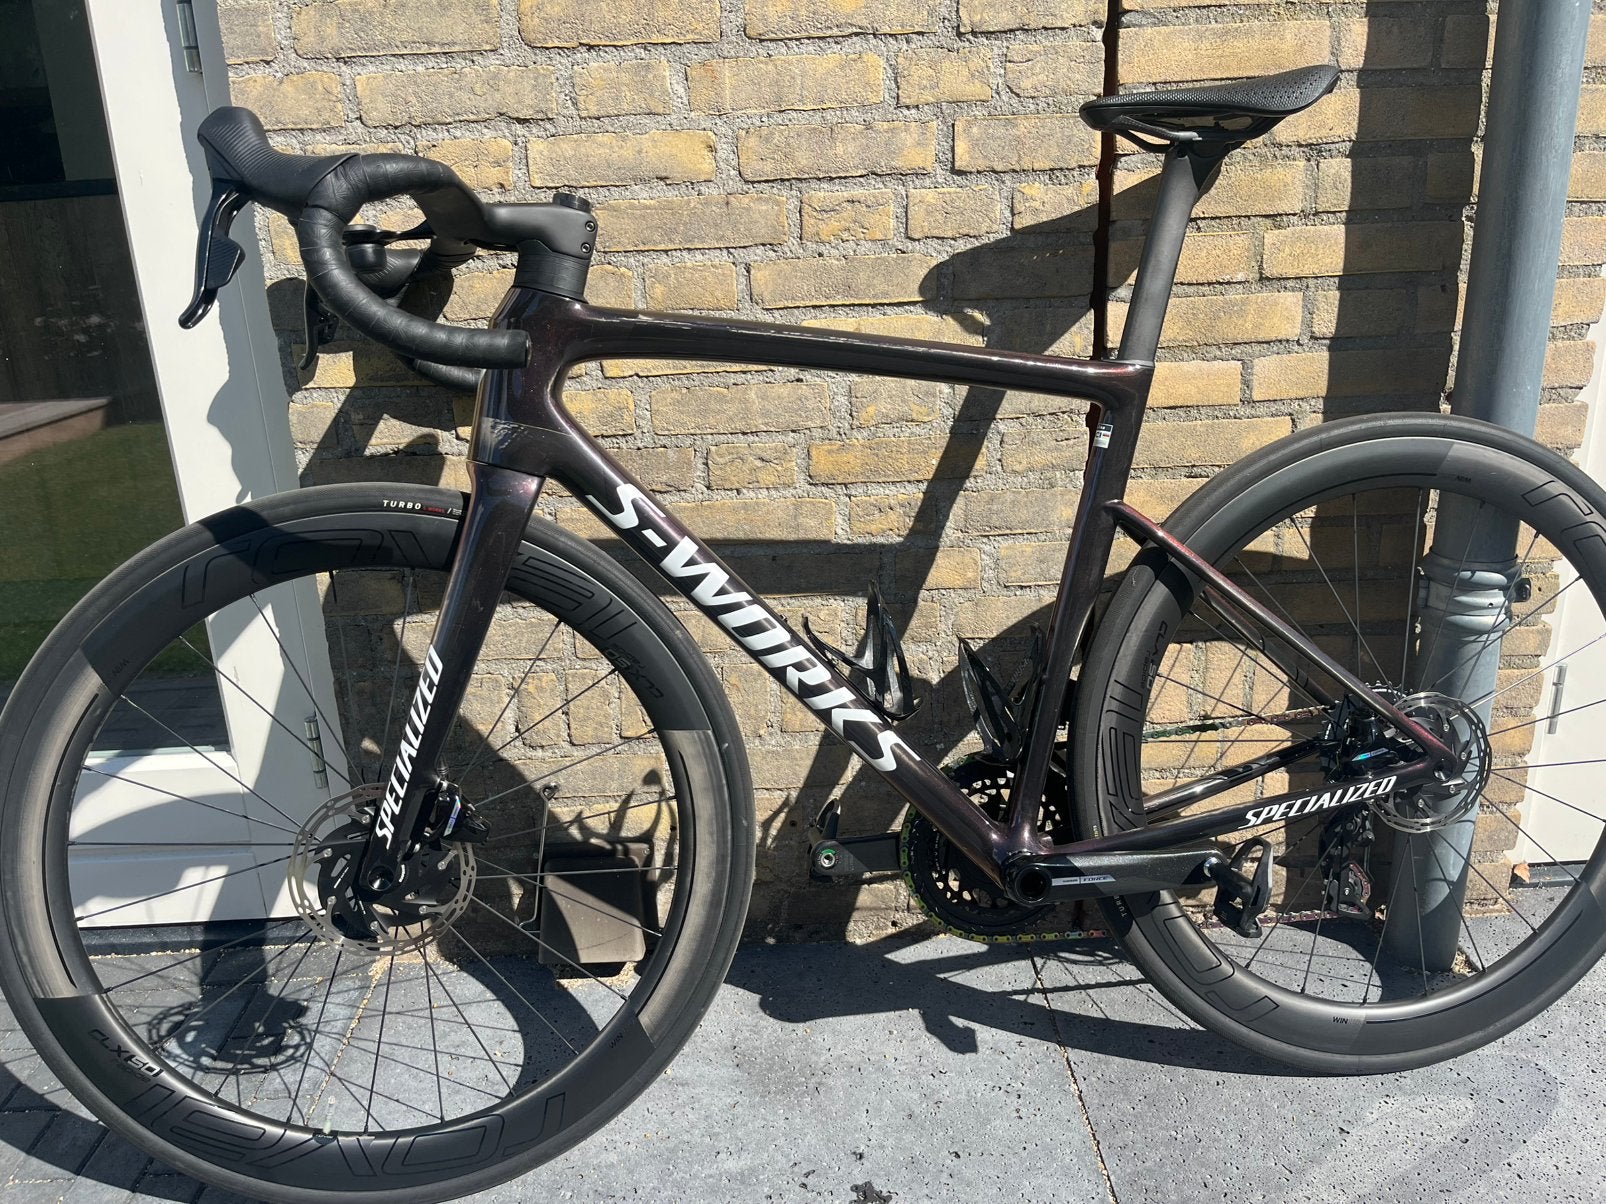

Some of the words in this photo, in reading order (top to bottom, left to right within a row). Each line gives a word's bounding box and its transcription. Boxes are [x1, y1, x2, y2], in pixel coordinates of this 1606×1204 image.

[382, 499, 422, 510] TURBO
[585, 483, 922, 772] S-WORKS
[375, 644, 443, 850] SPECIALIZED
[1237, 775, 1398, 830] SPECIALIZED
[1332, 1016, 1349, 1025] WIN
